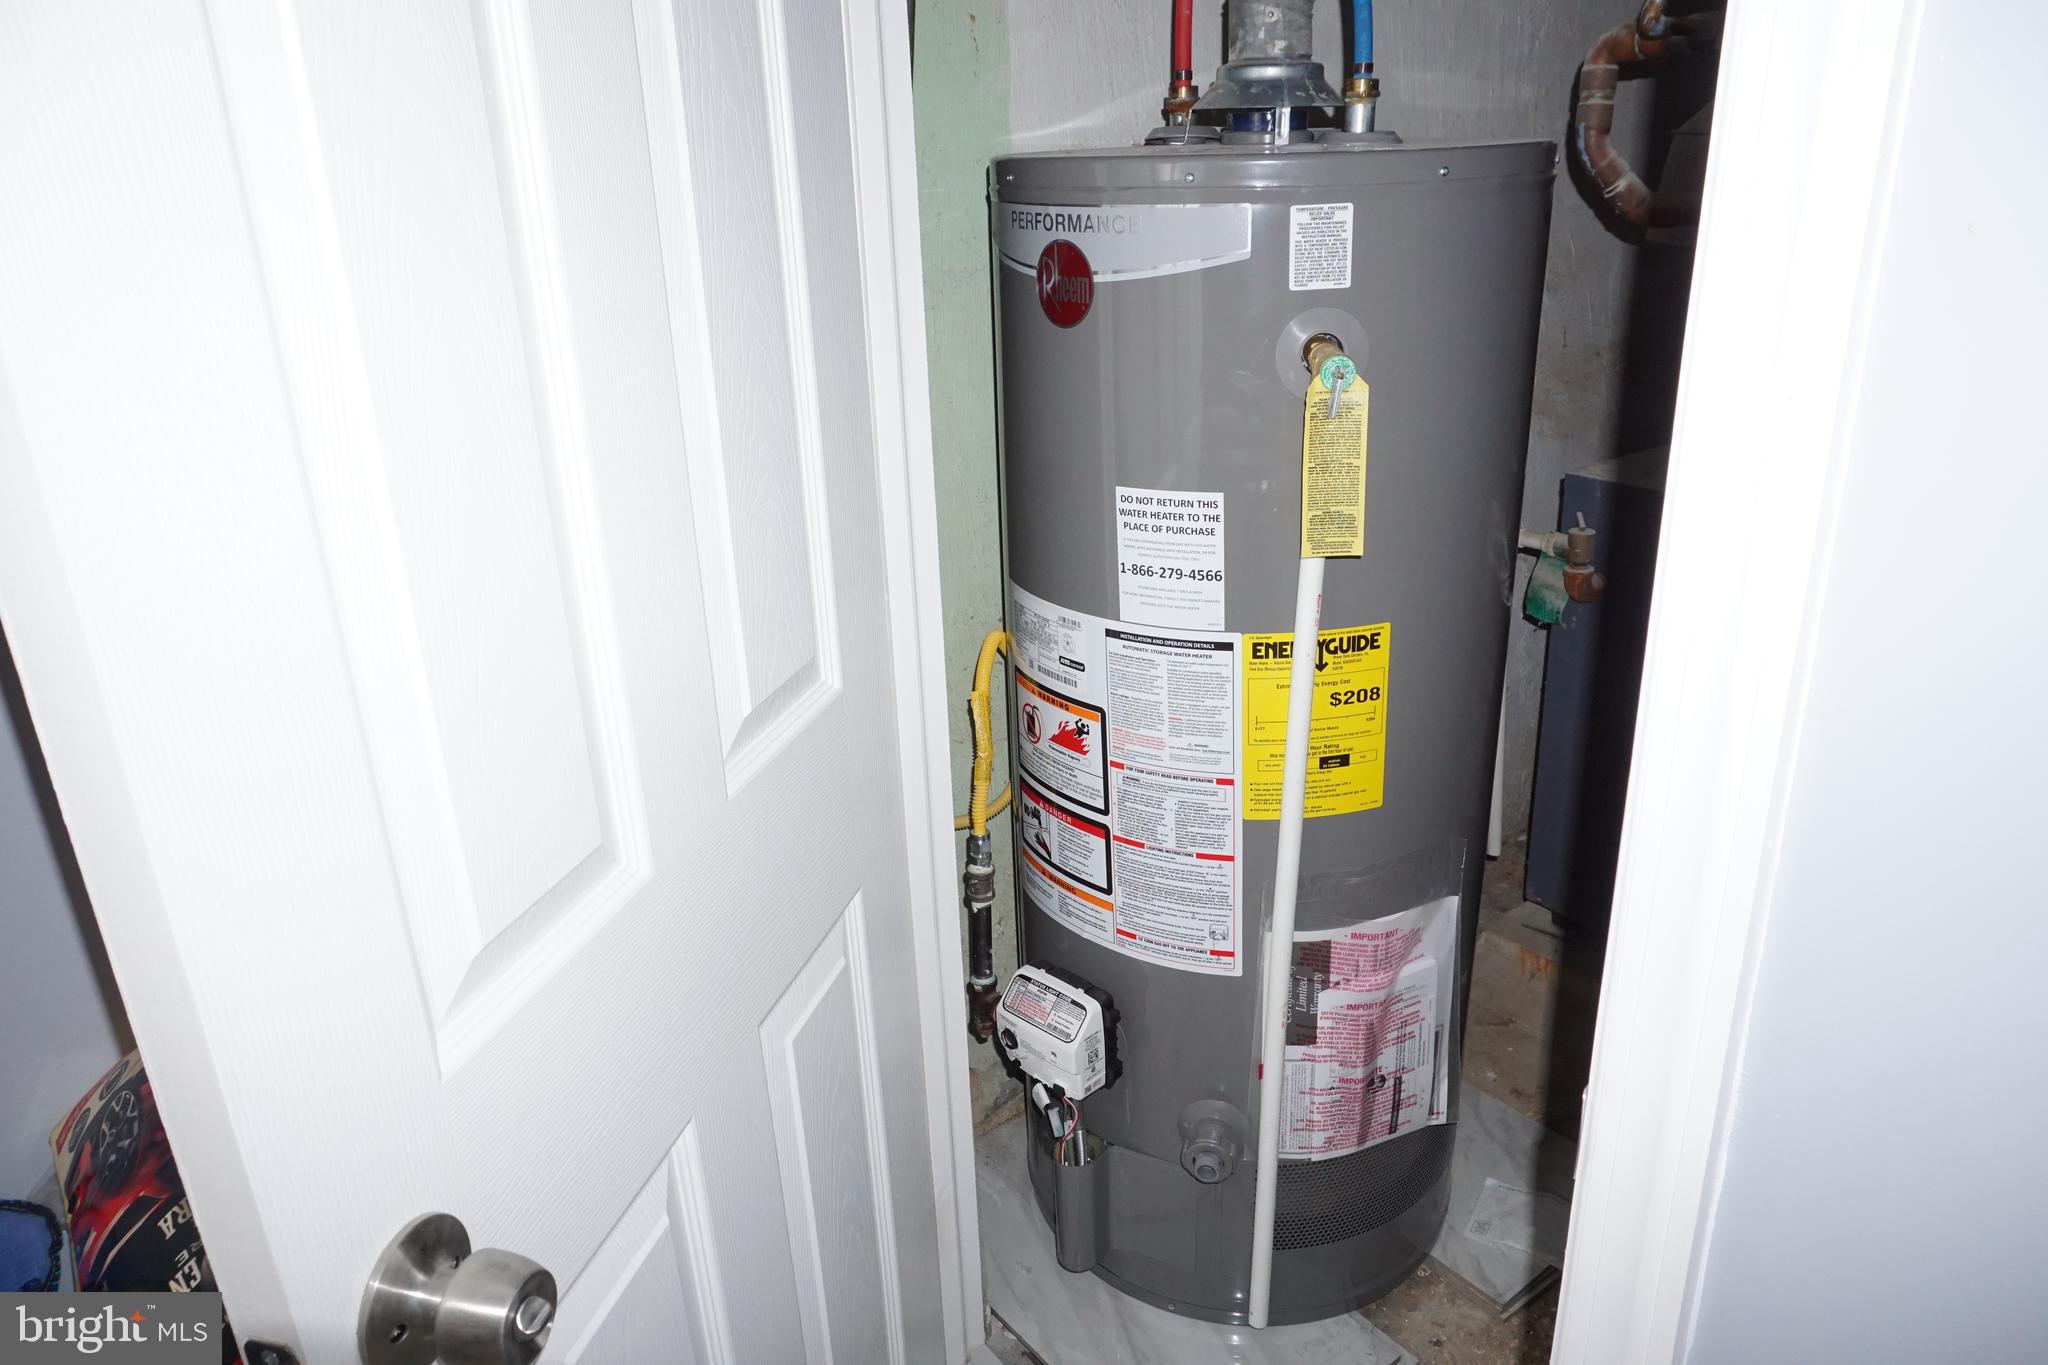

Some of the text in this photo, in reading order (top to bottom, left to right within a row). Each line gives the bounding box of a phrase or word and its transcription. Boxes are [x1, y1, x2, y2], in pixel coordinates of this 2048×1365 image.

[1011, 210, 1140, 234] PERFORMANCE
[1041, 243, 1089, 312] Rheem
[1120, 494, 1219, 509] DO NOT RETURN THIS
[1118, 508, 1221, 523] WATER HEATER TO THE
[1123, 521, 1216, 536] PLACE OF PURCHASE
[1120, 562, 1223, 582] 1-866-279-4566
[1120, 633, 1152, 644] INSTALLATION
[1164, 640, 1193, 648] OPERATION
[1122, 644, 1150, 653] AUTOMATIC
[1150, 648, 1173, 656] STORAGE
[1252, 632, 1381, 667] ENEYGUIDE
[1037, 691, 1069, 711] WARNING
[1329, 686, 1381, 707] $208
[1044, 803, 1072, 824] DANGER
[1146, 845, 1194, 858] LIGHTING INSTRUCTIONS
[1048, 874, 1076, 895] WARNING
[1351, 928, 1399, 941] IMPORTANT
[1030, 978, 1072, 1003] STATUS LIGHT CODE
[1296, 975, 1308, 1012] Limited
